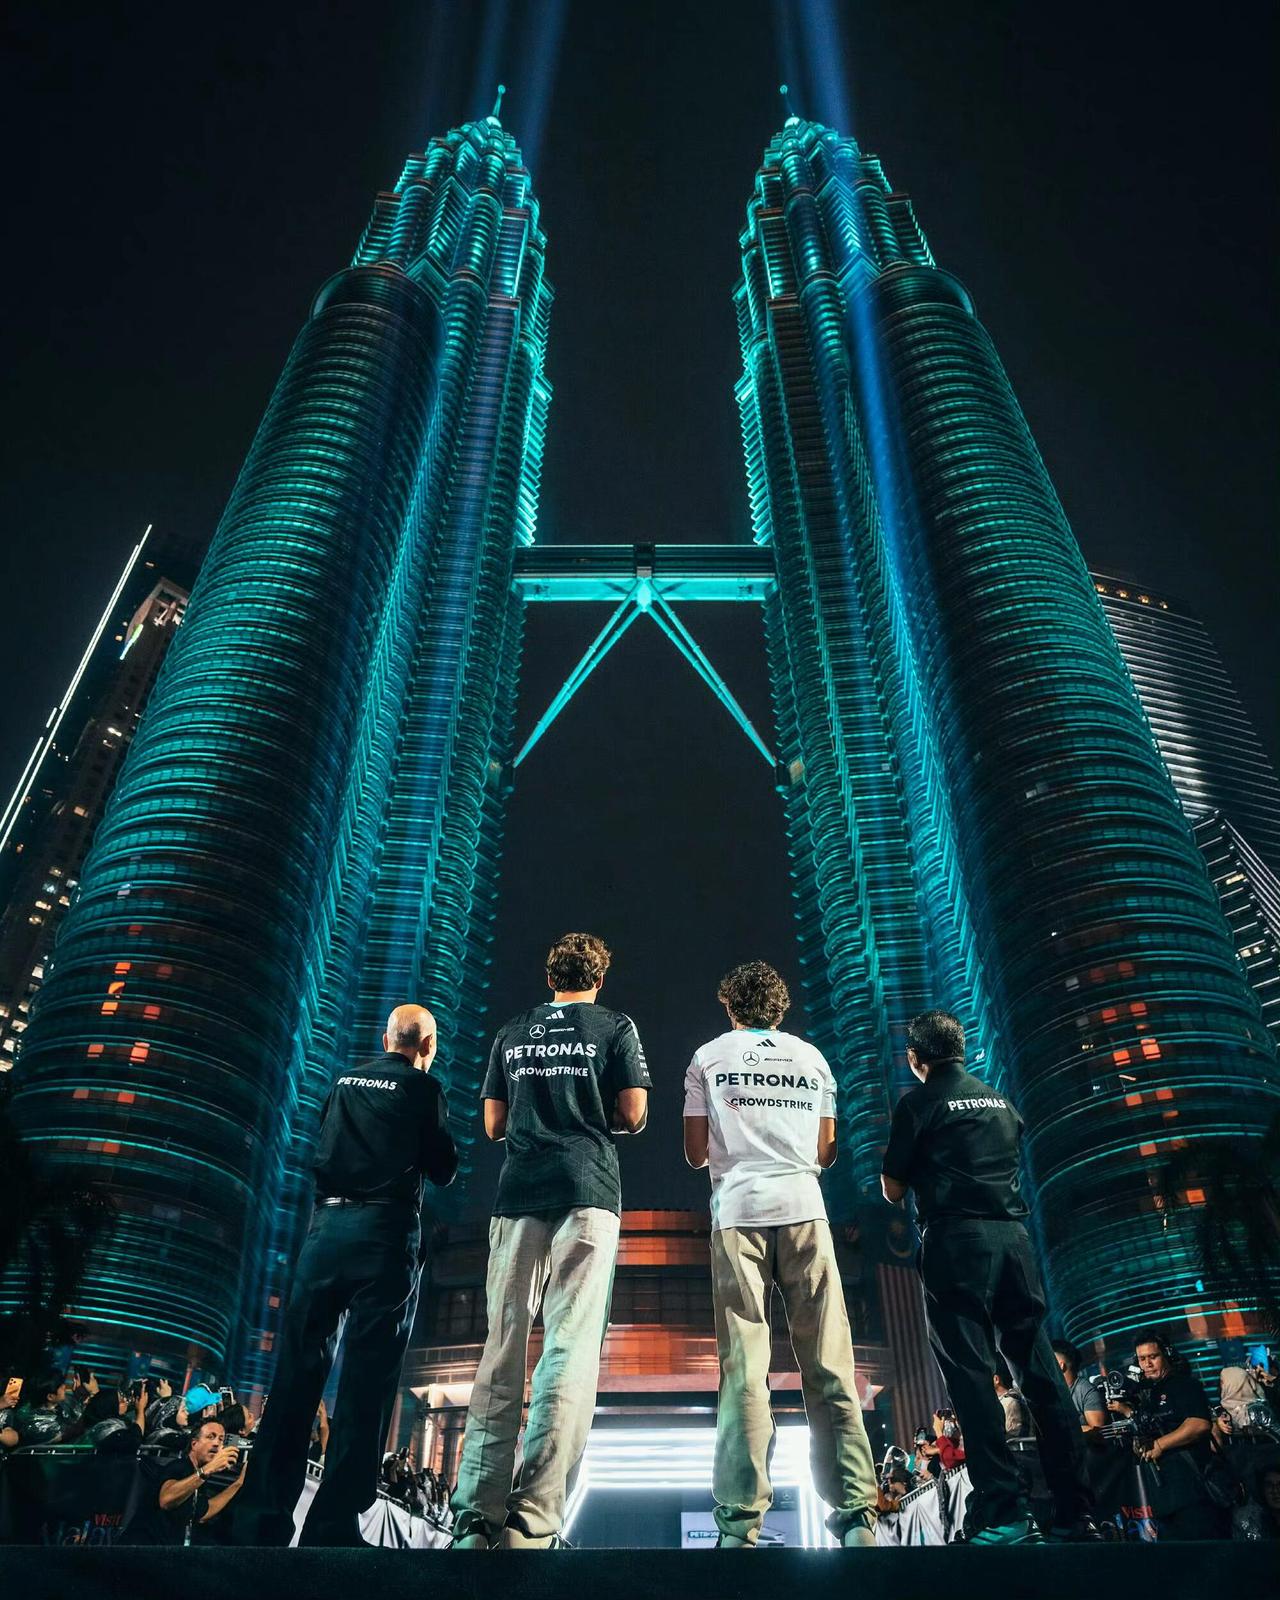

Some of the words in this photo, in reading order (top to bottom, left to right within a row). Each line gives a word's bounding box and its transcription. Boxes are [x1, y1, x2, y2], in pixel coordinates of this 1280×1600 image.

[505, 1043, 597, 1063] PETRONAS
[515, 1066, 589, 1077] CROWDSTRIKE
[337, 1076, 397, 1090] PETRONAS
[715, 1072, 819, 1091] PETRONAS
[730, 1097, 813, 1111] CROWDSTRIKE
[947, 1098, 1006, 1111] PETRONAS
